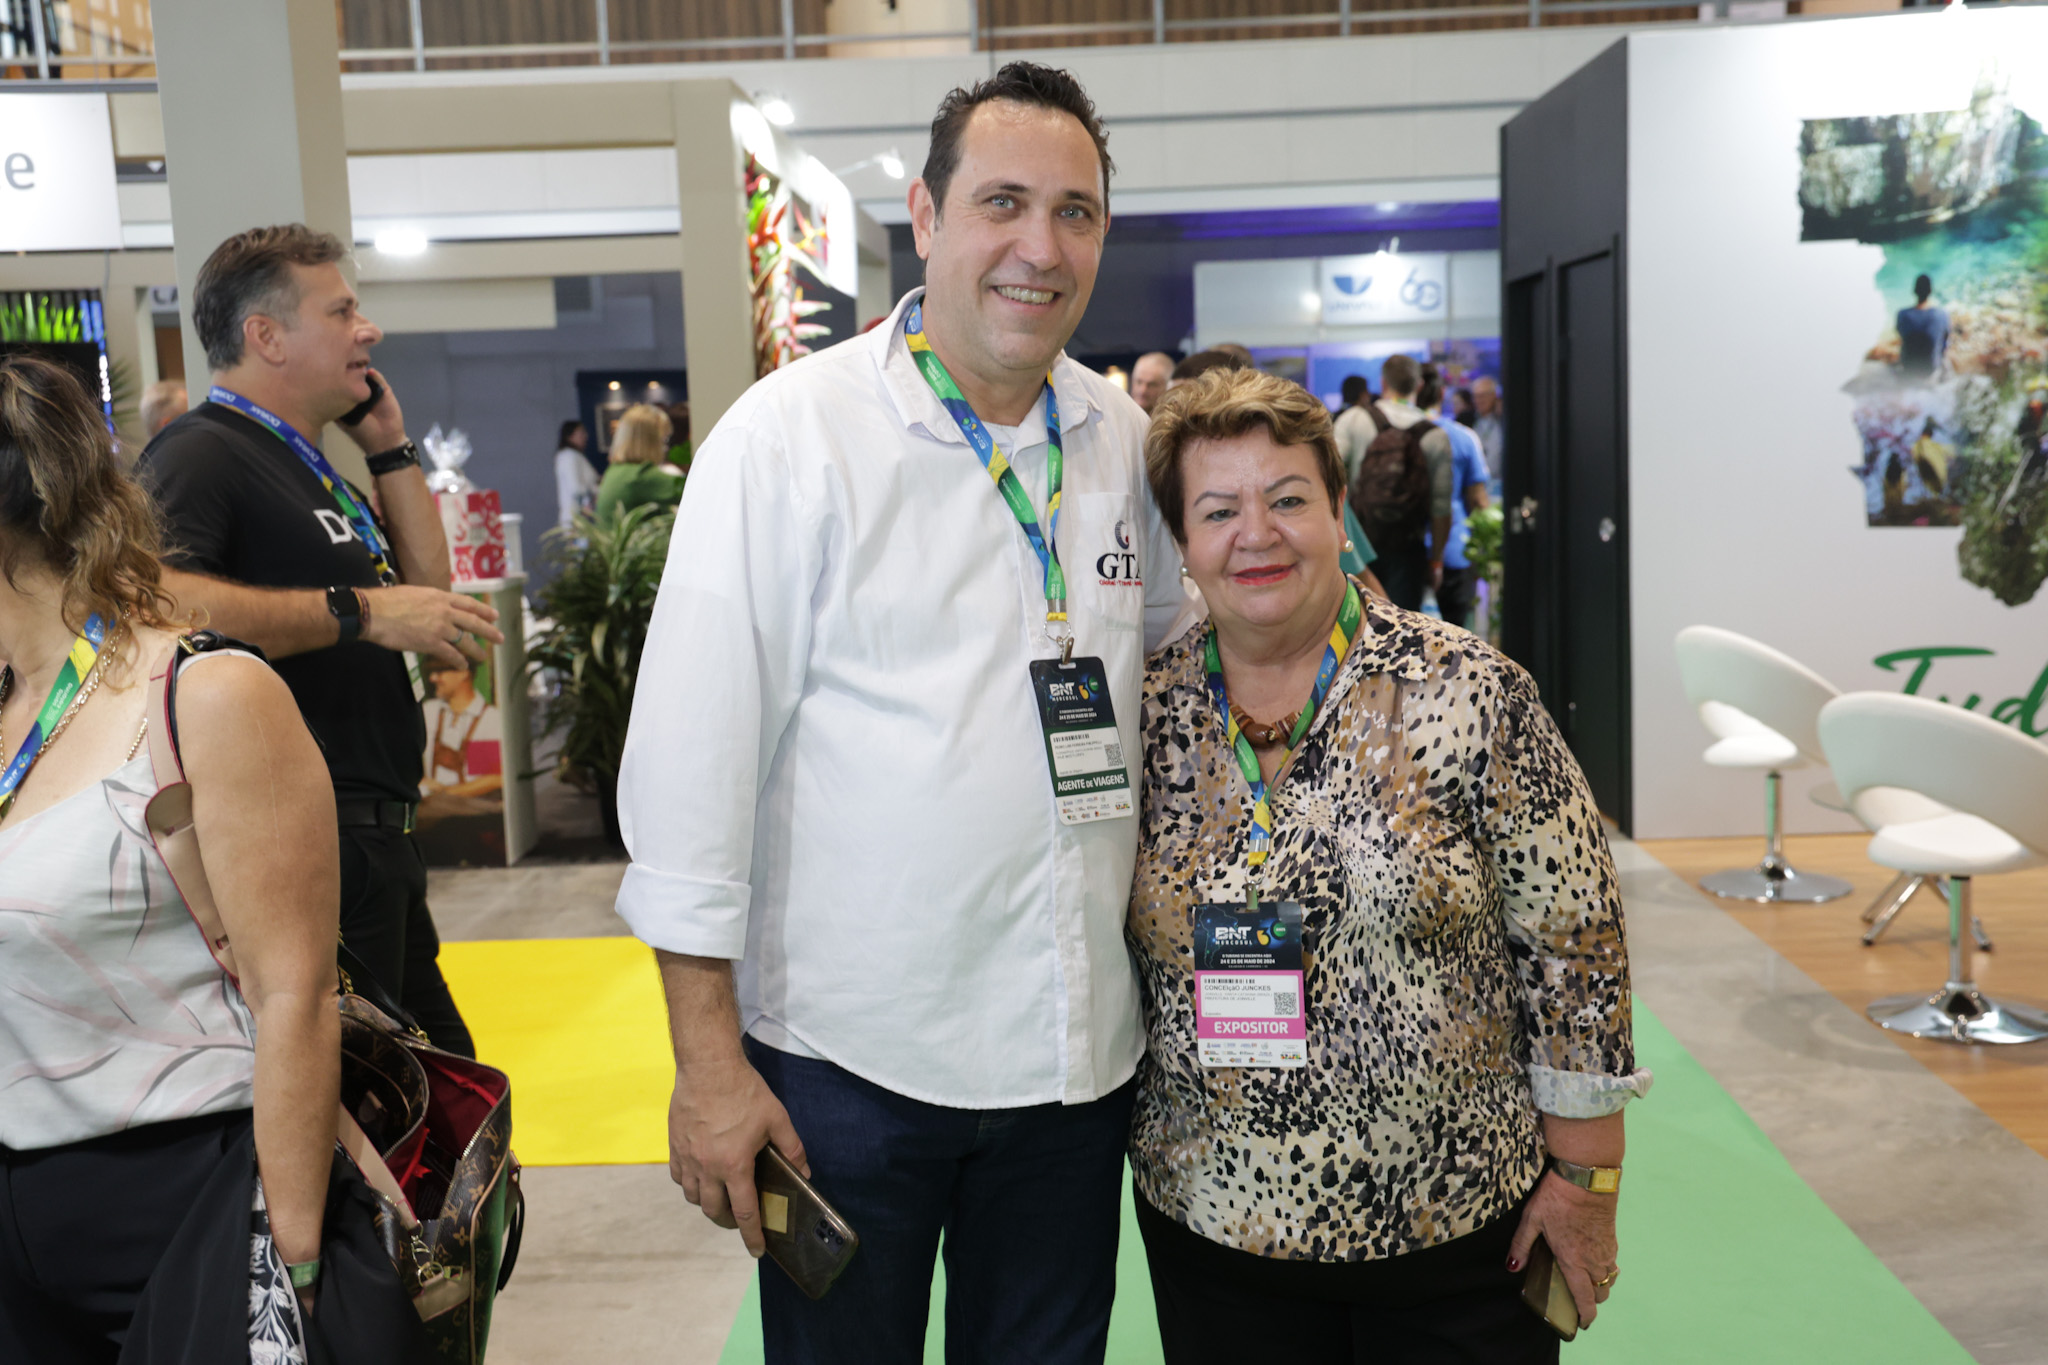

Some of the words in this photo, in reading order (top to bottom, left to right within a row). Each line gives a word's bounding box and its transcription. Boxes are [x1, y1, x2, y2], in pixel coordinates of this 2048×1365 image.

[1096, 553, 1141, 579] GT
[1049, 681, 1075, 697] BNT
[1057, 779, 1085, 792] AGENTE
[1085, 780, 1094, 788] DE
[1093, 774, 1125, 787] VIAGENS
[1215, 926, 1252, 940] BNT
[1214, 1021, 1288, 1034] EXPOSITOR
